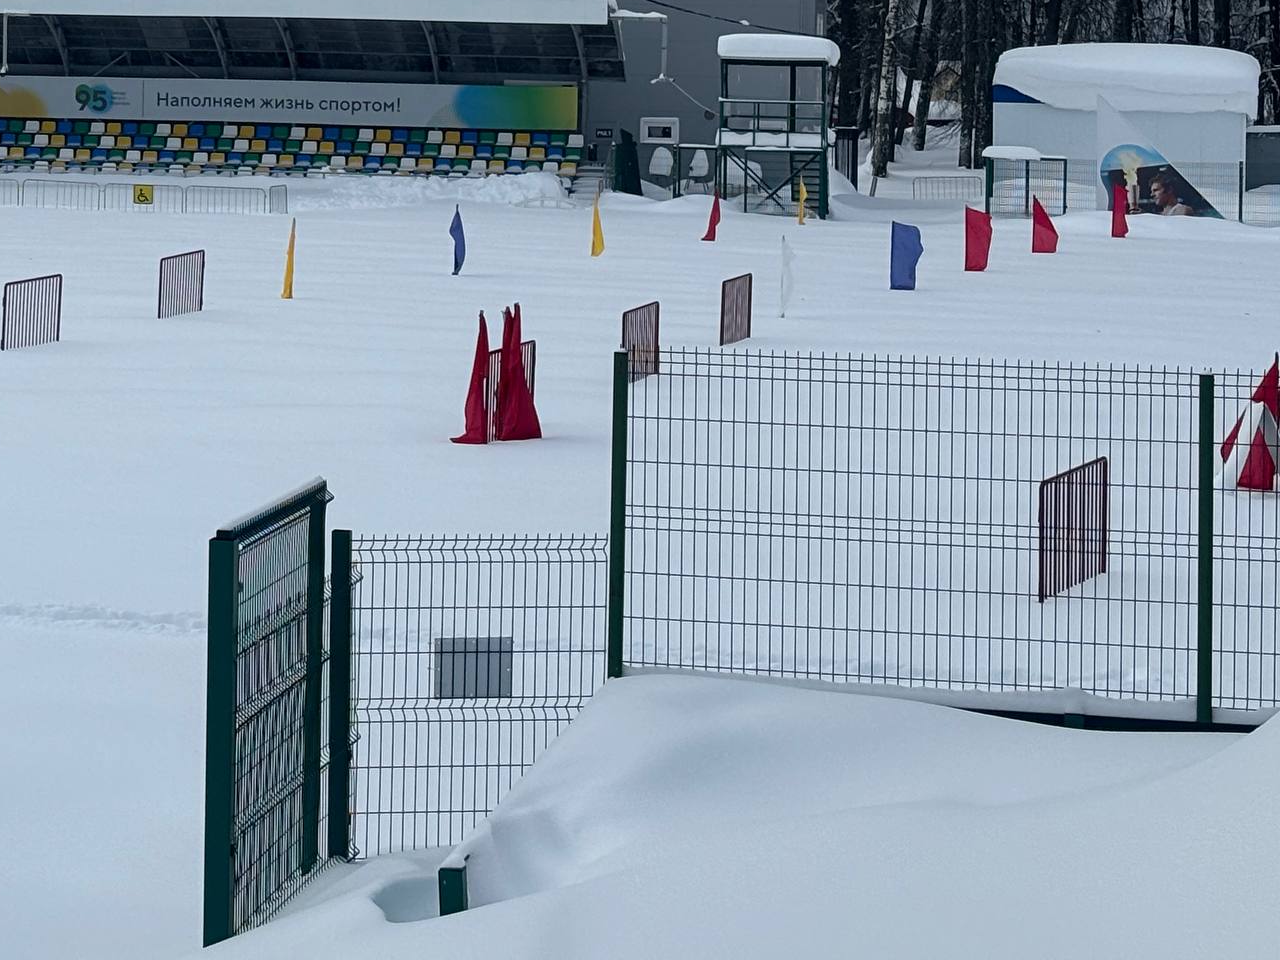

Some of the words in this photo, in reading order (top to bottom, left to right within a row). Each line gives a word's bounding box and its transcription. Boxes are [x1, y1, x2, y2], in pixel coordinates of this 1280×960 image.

[75, 87, 108, 112] 95
[157, 92, 256, 108] Наполняем
[259, 98, 314, 110] жизнь
[318, 97, 401, 115] спортом!
